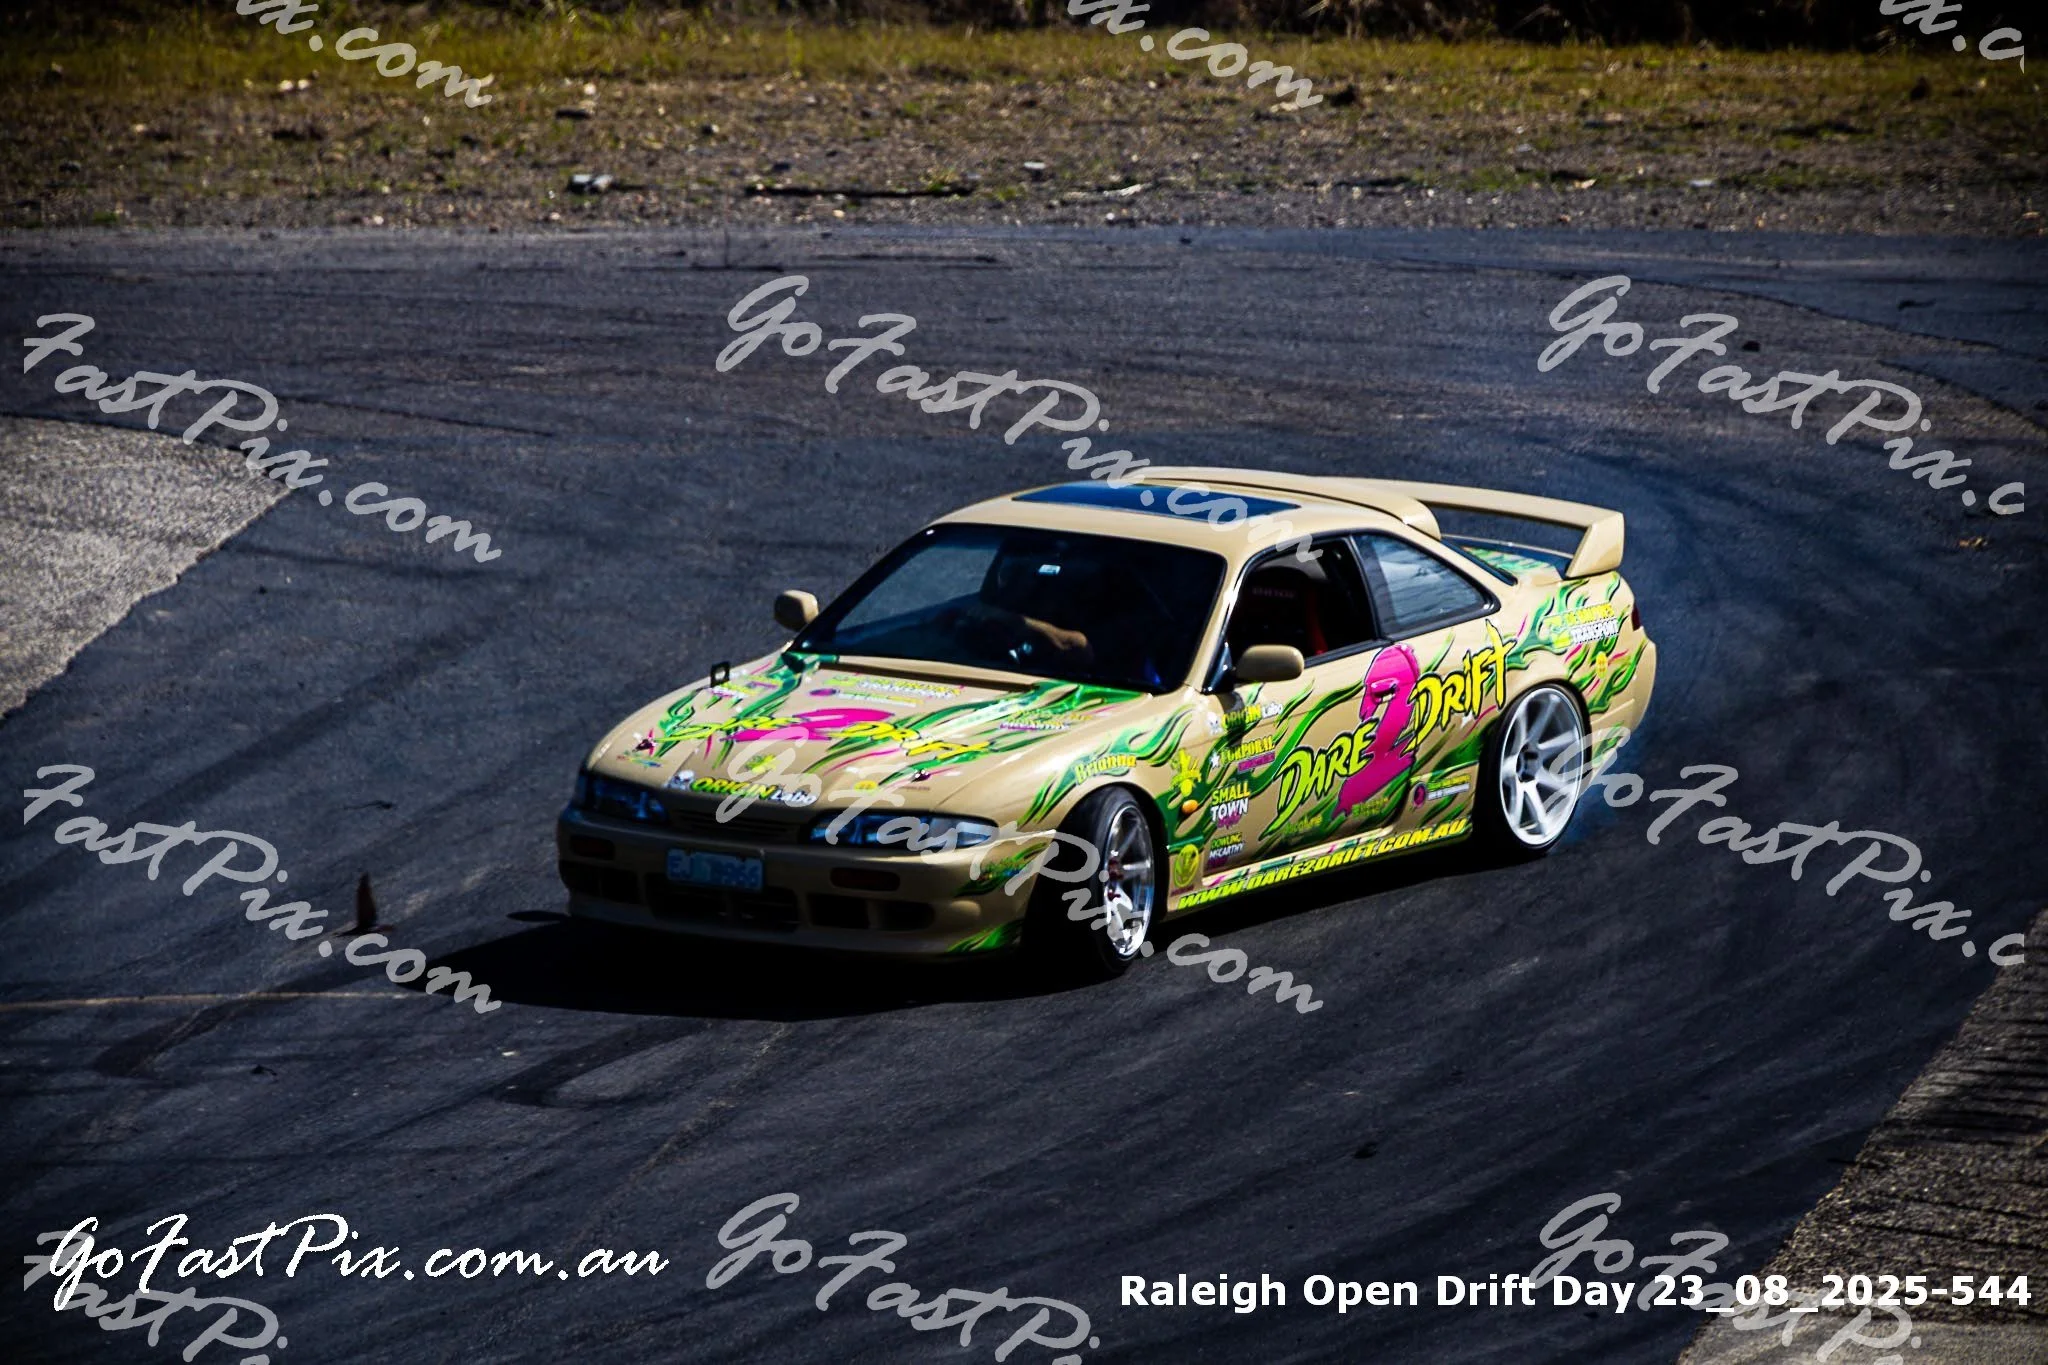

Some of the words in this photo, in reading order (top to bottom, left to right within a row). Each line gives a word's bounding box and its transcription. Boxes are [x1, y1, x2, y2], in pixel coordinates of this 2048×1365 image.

[1261, 718, 1379, 837] DARE
[1407, 619, 1517, 752] DRIFT
[1075, 754, 1137, 785] Brianna
[689, 776, 779, 800] ORIGIN
[768, 788, 817, 804] Labo
[1211, 781, 1250, 806] SMALL
[1210, 798, 1250, 823] TOWN
[1177, 817, 1469, 909] WWW.DARE2DRIFT.COM.AU
